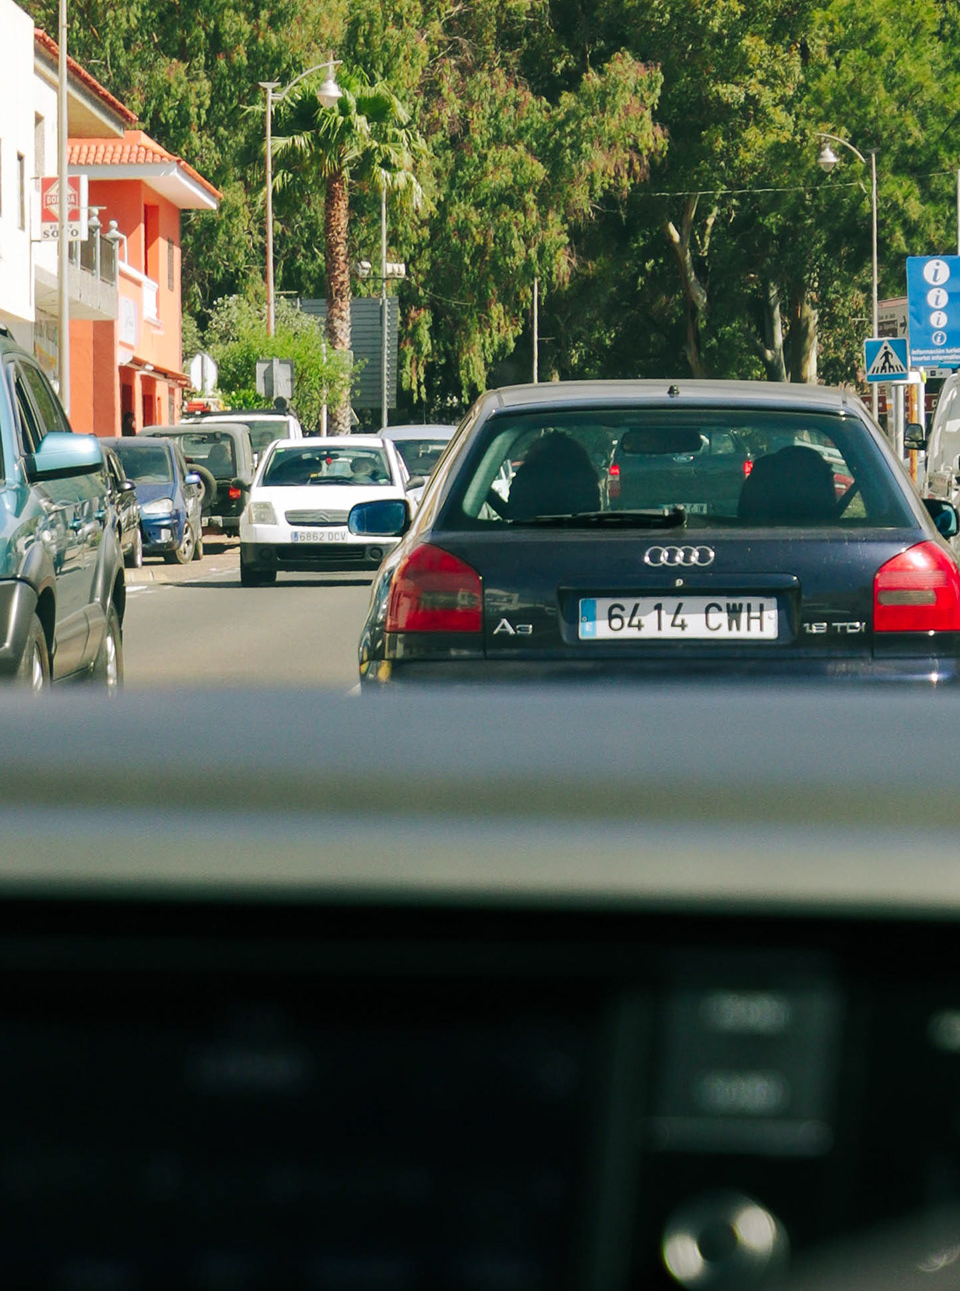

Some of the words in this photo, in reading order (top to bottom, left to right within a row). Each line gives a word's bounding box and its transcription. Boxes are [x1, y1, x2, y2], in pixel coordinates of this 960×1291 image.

[43, 229, 79, 238] SOO
[299, 531, 325, 541] 6862
[607, 602, 688, 632] 6414
[704, 602, 765, 632] CWH
[493, 618, 533, 635] A3
[832, 621, 866, 633] TDI
